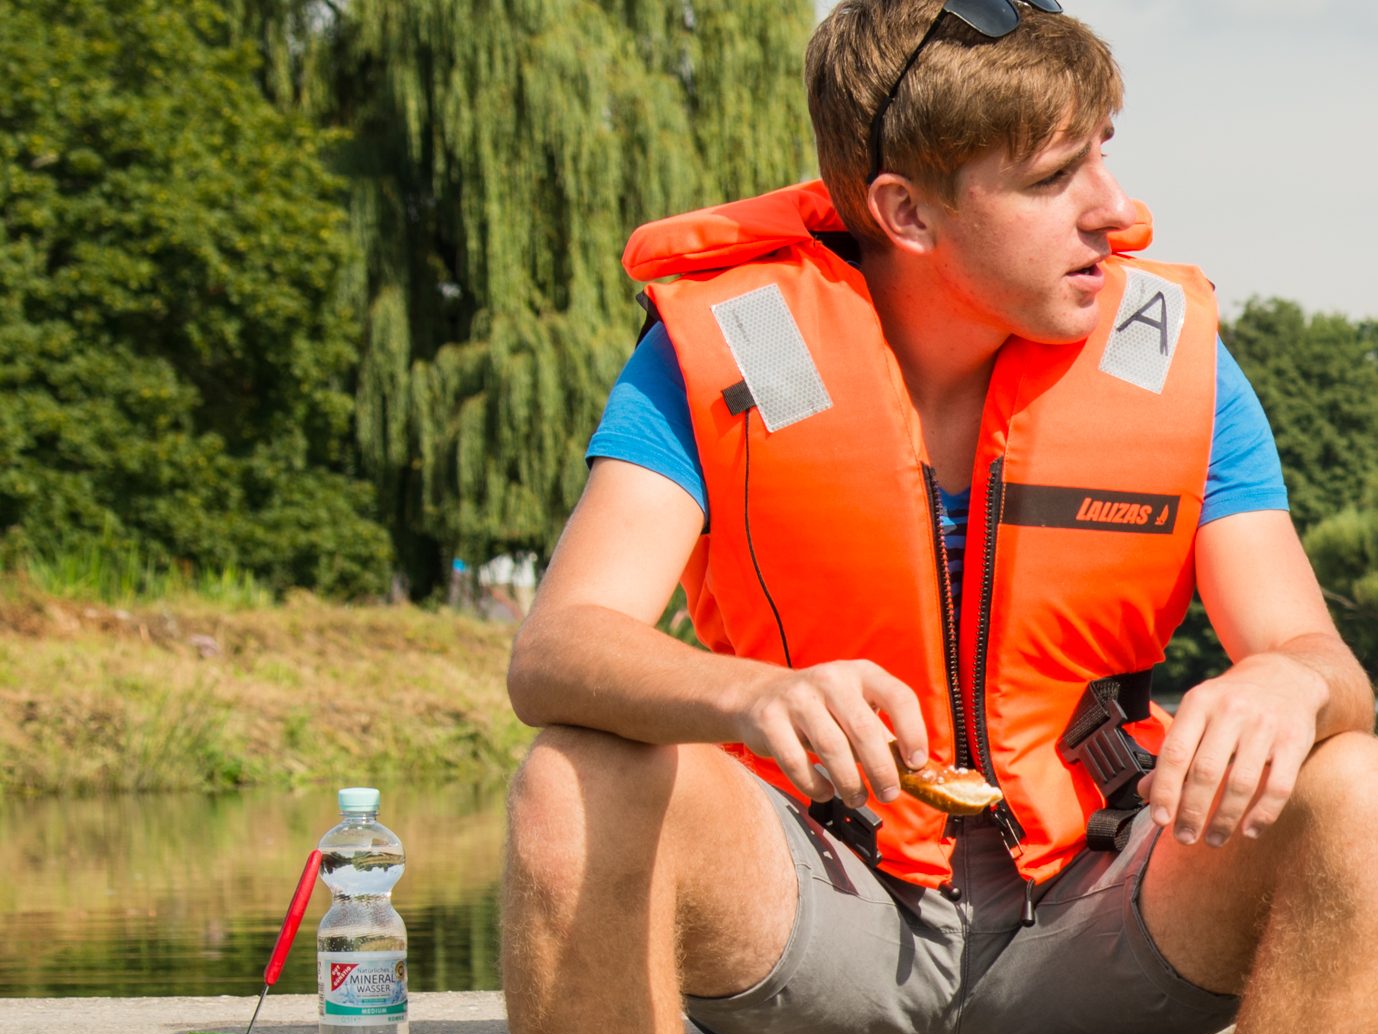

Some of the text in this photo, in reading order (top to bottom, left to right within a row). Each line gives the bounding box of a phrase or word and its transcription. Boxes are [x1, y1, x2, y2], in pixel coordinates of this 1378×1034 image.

[1116, 291, 1168, 356] A
[1075, 497, 1153, 525] LALIZAS
[350, 974, 396, 984] MINERAL
[357, 984, 391, 993] WASSER
